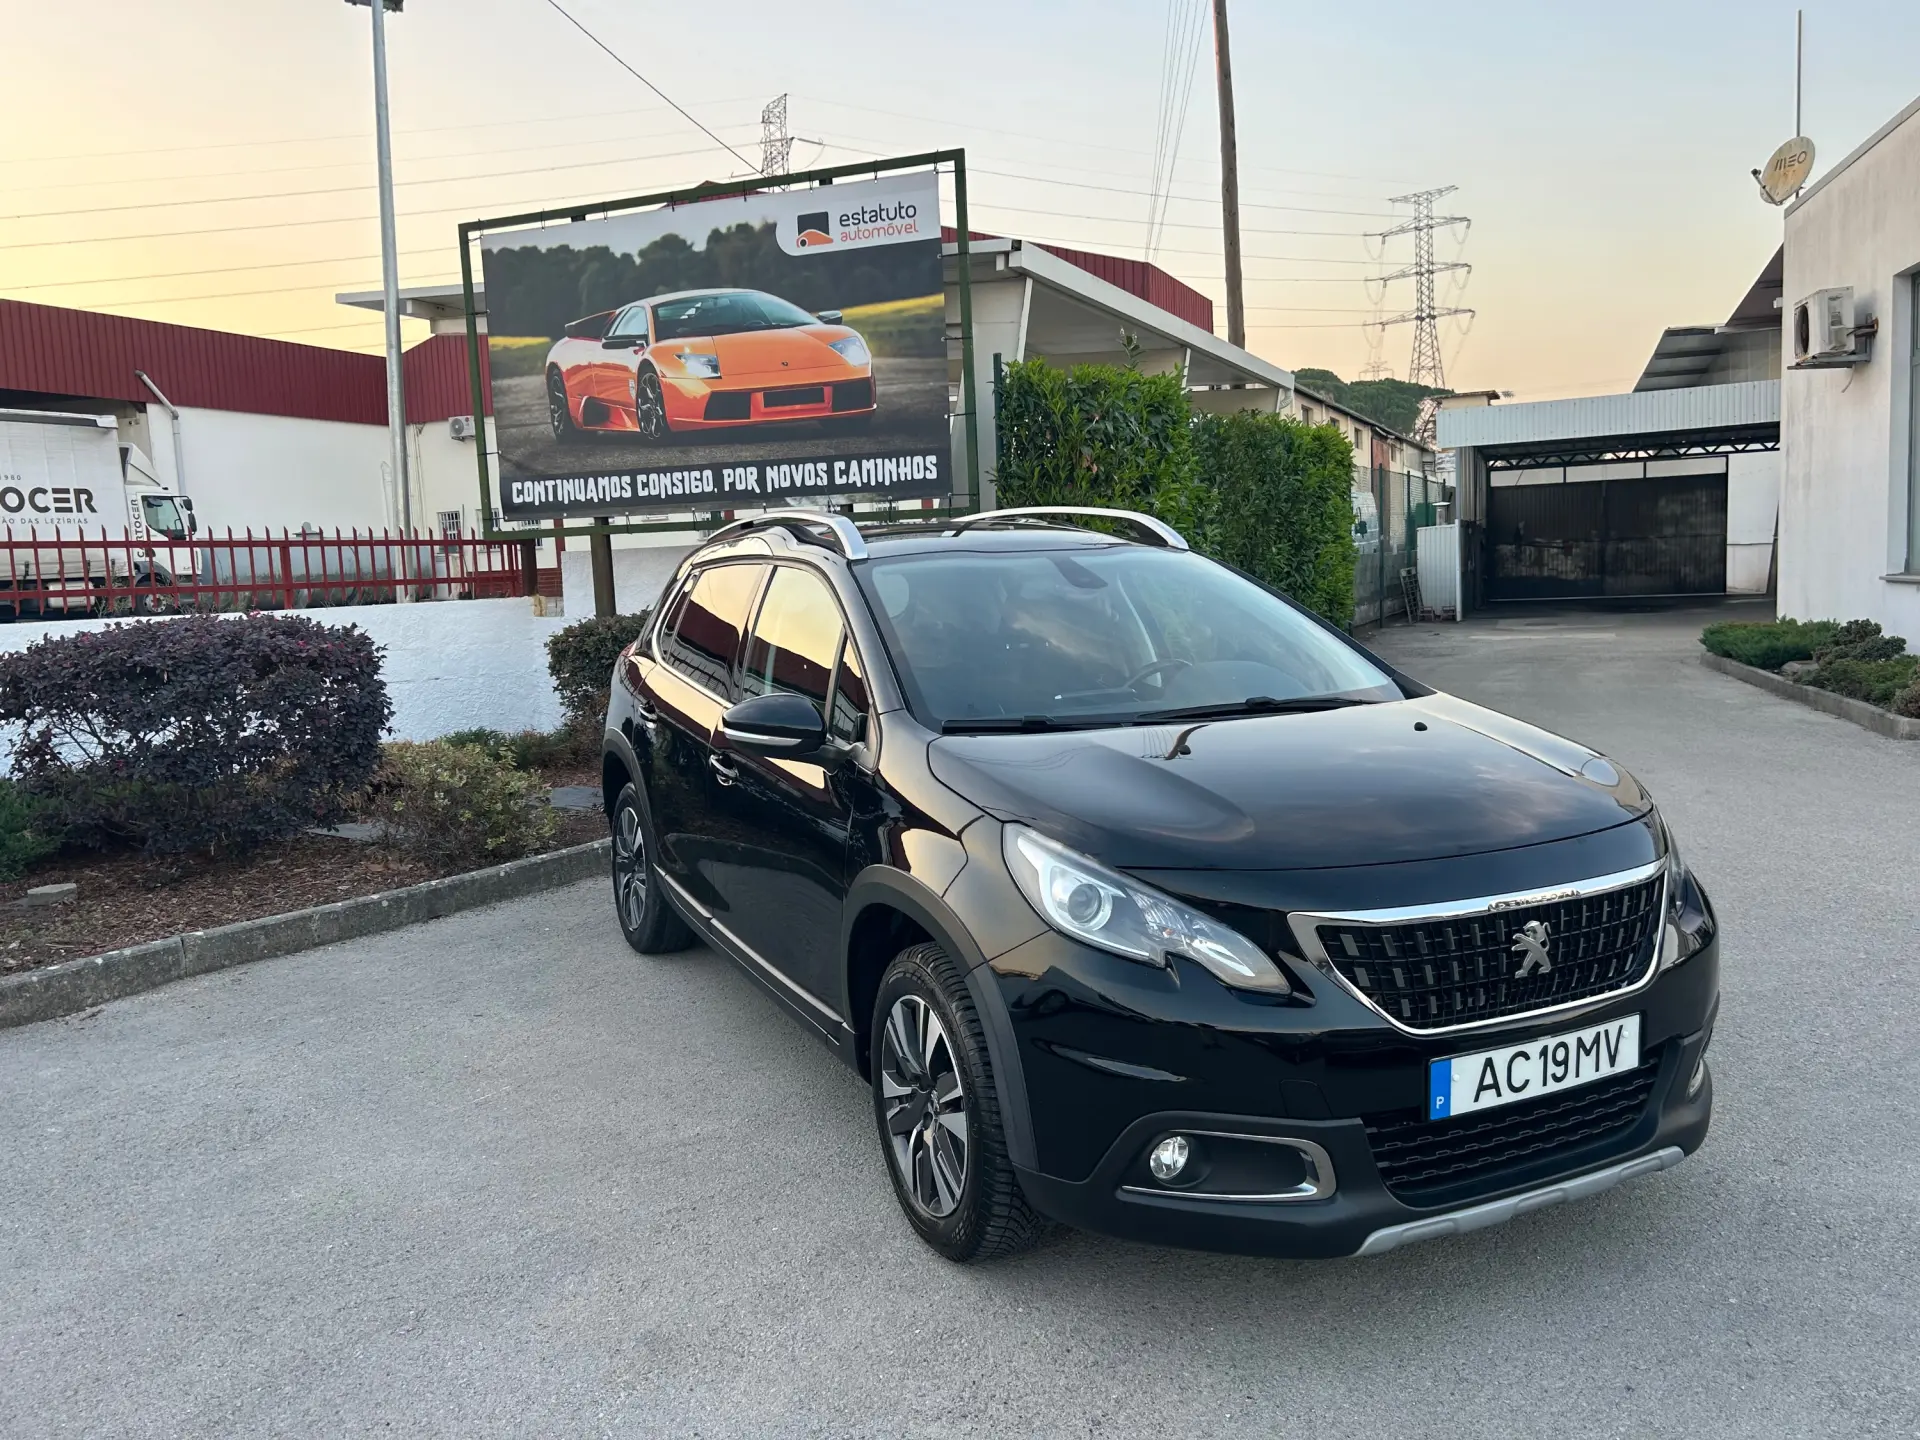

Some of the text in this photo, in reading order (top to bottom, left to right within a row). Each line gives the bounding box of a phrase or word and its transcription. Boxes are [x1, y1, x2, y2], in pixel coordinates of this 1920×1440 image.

[1774, 150, 1807, 171] MEO
[839, 201, 917, 227] estatuto
[840, 219, 919, 242] automóvel
[511, 455, 938, 506] CONTINUAMOS CONSIGO, POR NOVOS CAMINHOS
[20, 517, 40, 525] DAS
[130, 499, 145, 558] CRTOCER
[1436, 1096, 1445, 1109] P
